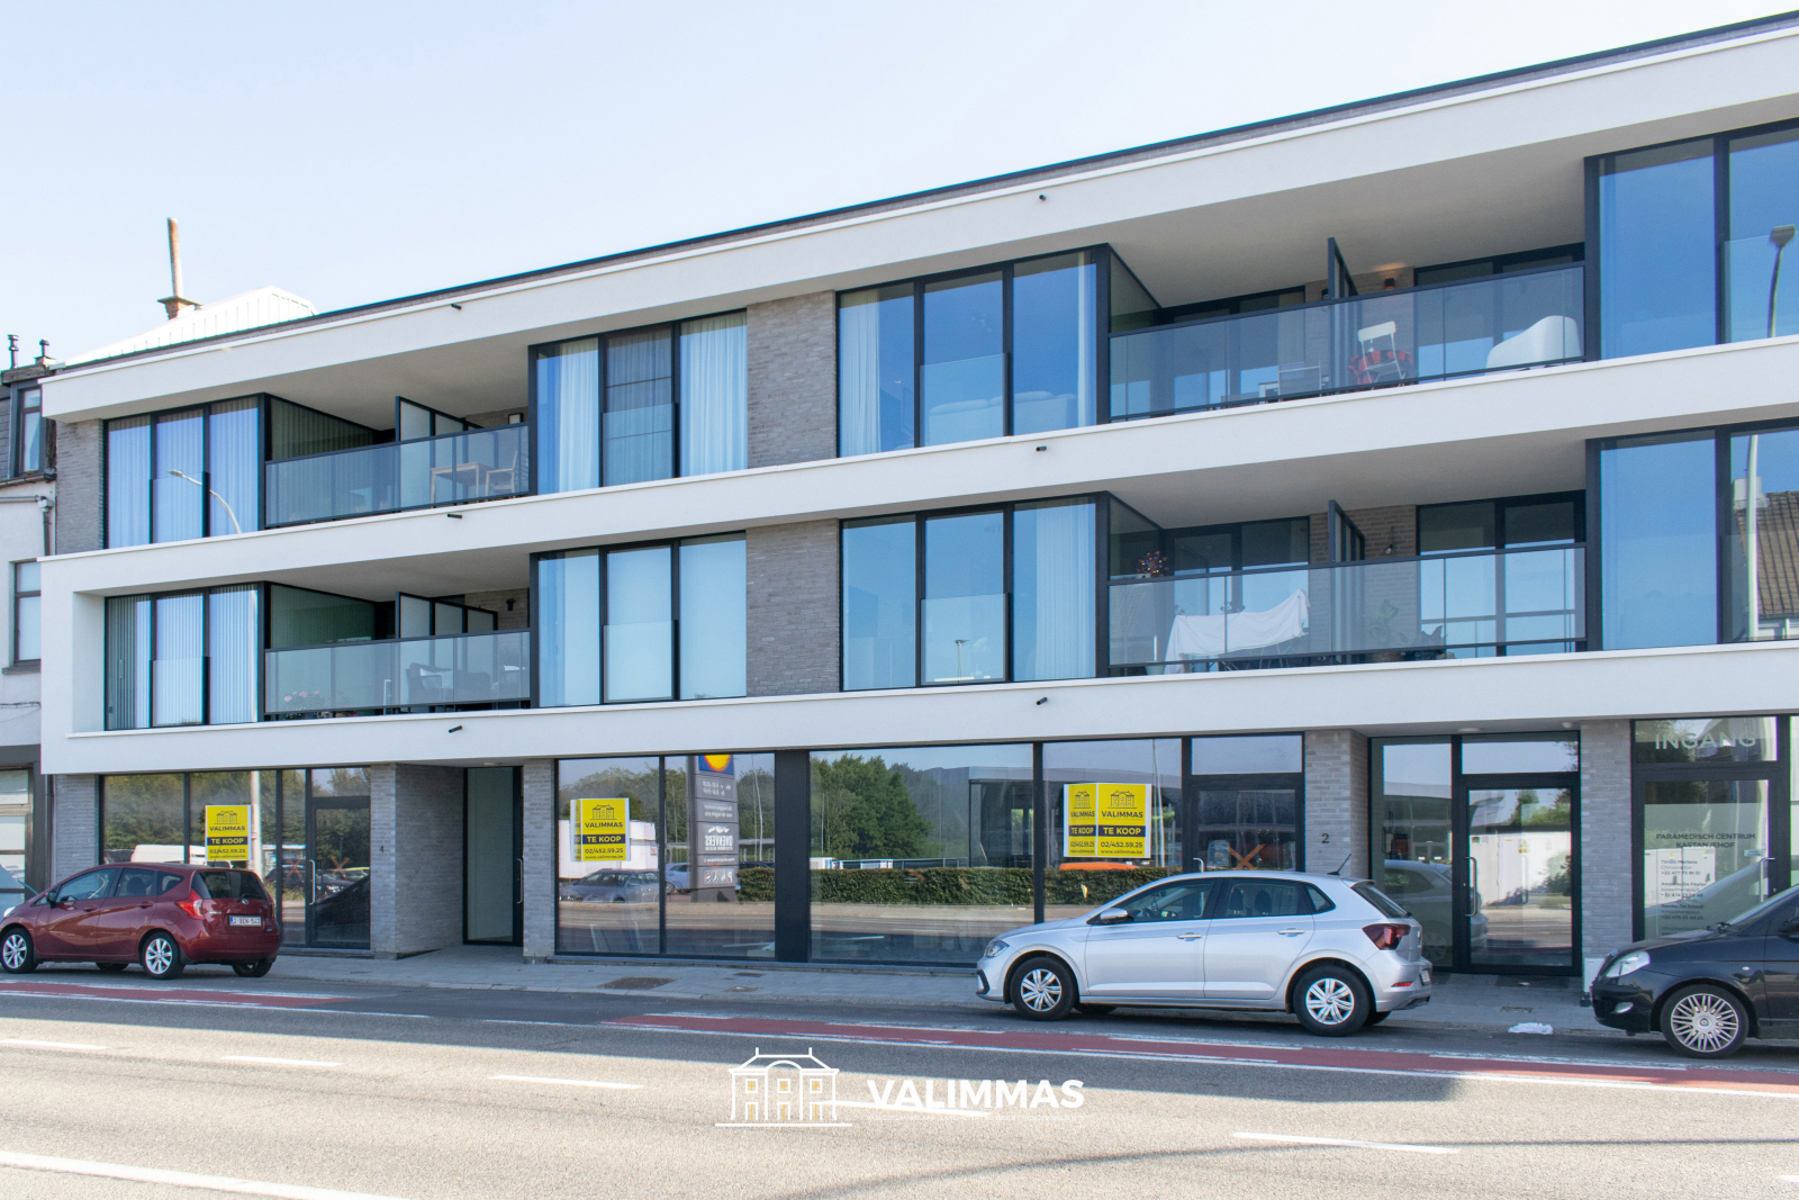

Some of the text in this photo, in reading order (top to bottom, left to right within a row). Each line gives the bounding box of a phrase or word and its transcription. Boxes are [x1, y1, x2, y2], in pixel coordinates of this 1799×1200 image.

[1655, 732, 1756, 749] INGANG
[1321, 833, 1330, 844] 2
[379, 845, 384, 853] 4
